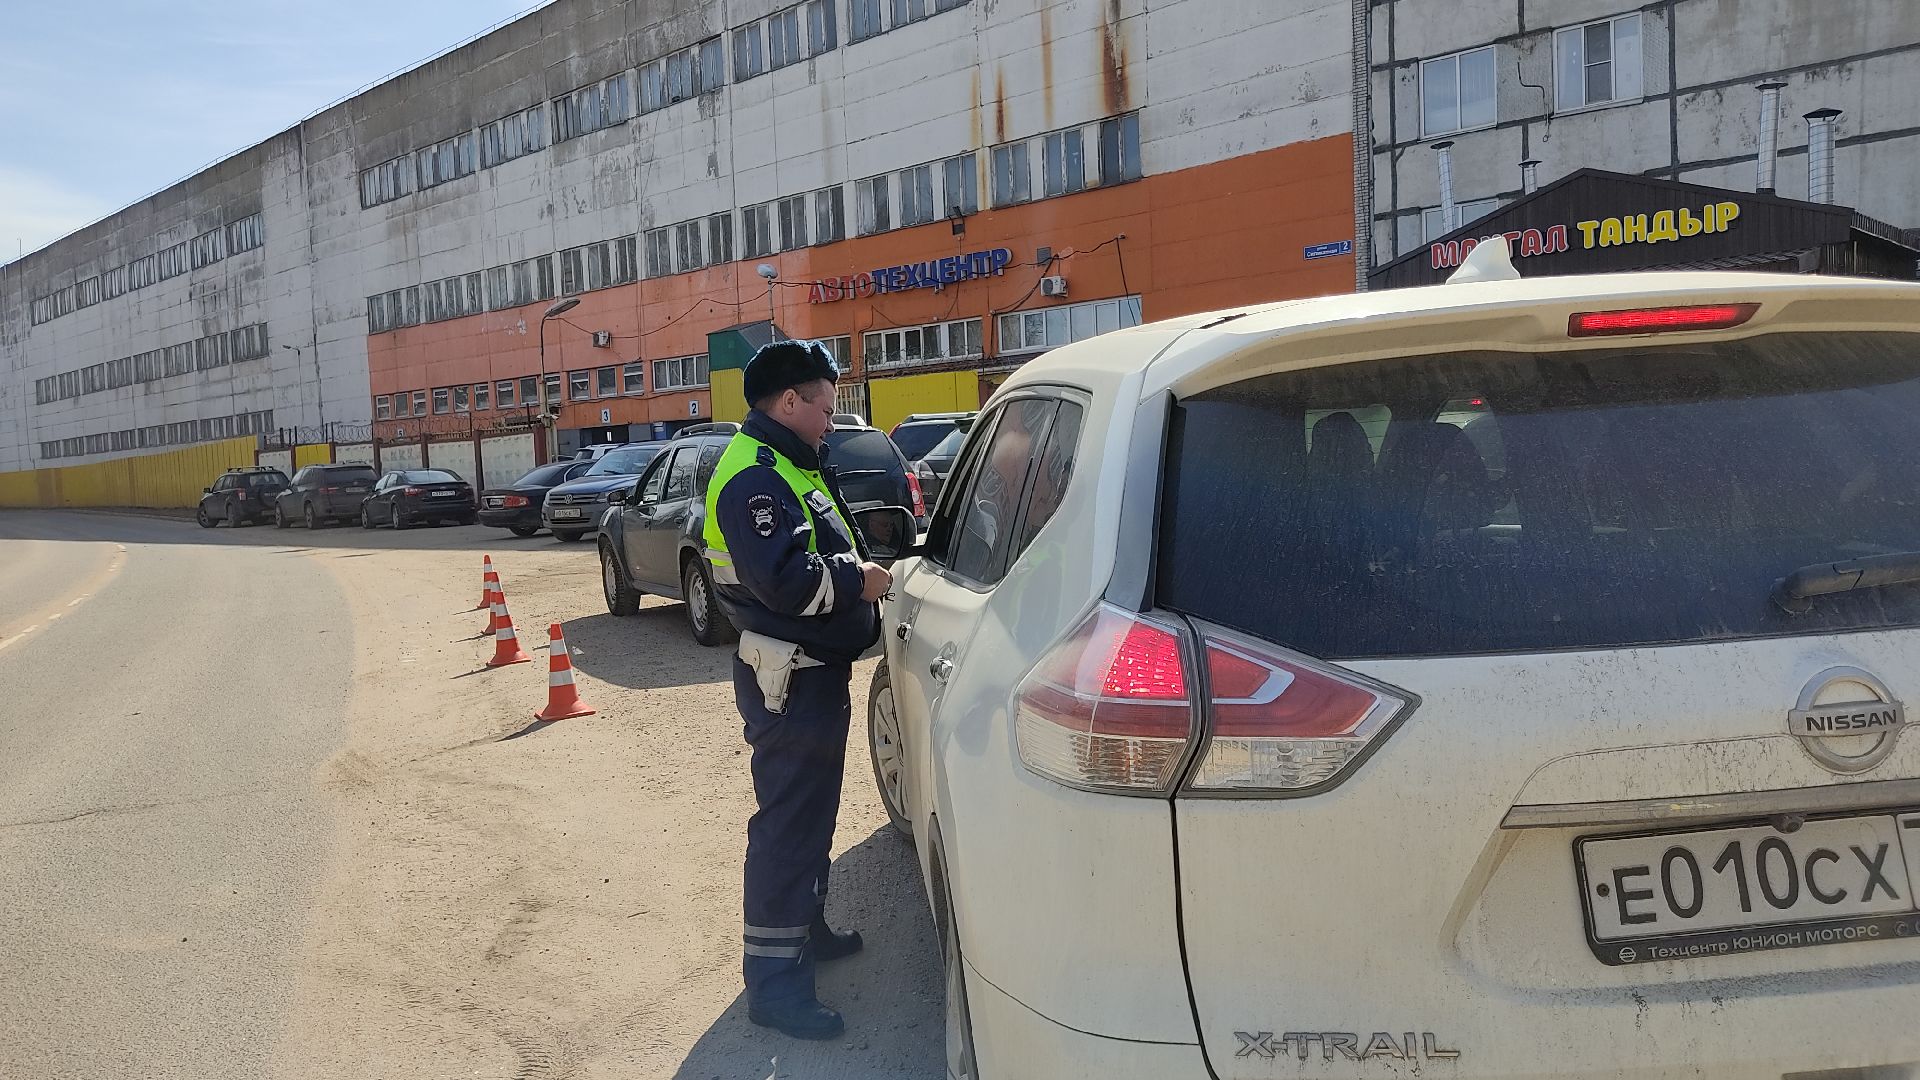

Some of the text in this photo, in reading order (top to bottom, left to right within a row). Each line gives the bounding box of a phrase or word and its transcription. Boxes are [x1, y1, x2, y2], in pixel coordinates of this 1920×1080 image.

[1343, 241, 1349, 250] 2
[1431, 202, 1740, 269] МАГАЛ ТАНДЫР
[808, 248, 1012, 304] АВТОТЕХЦЕНТР
[603, 411, 609, 421] 3
[691, 403, 697, 414] 2
[1805, 709, 1897, 732] NISSAN
[1612, 836, 1900, 925] Е010СХ
[1648, 941, 1729, 959] Техцентр
[1732, 932, 1800, 950] ЮНИОН
[1805, 924, 1880, 942] МОТОРС
[1233, 1031, 1461, 1059] X-TRAIL
